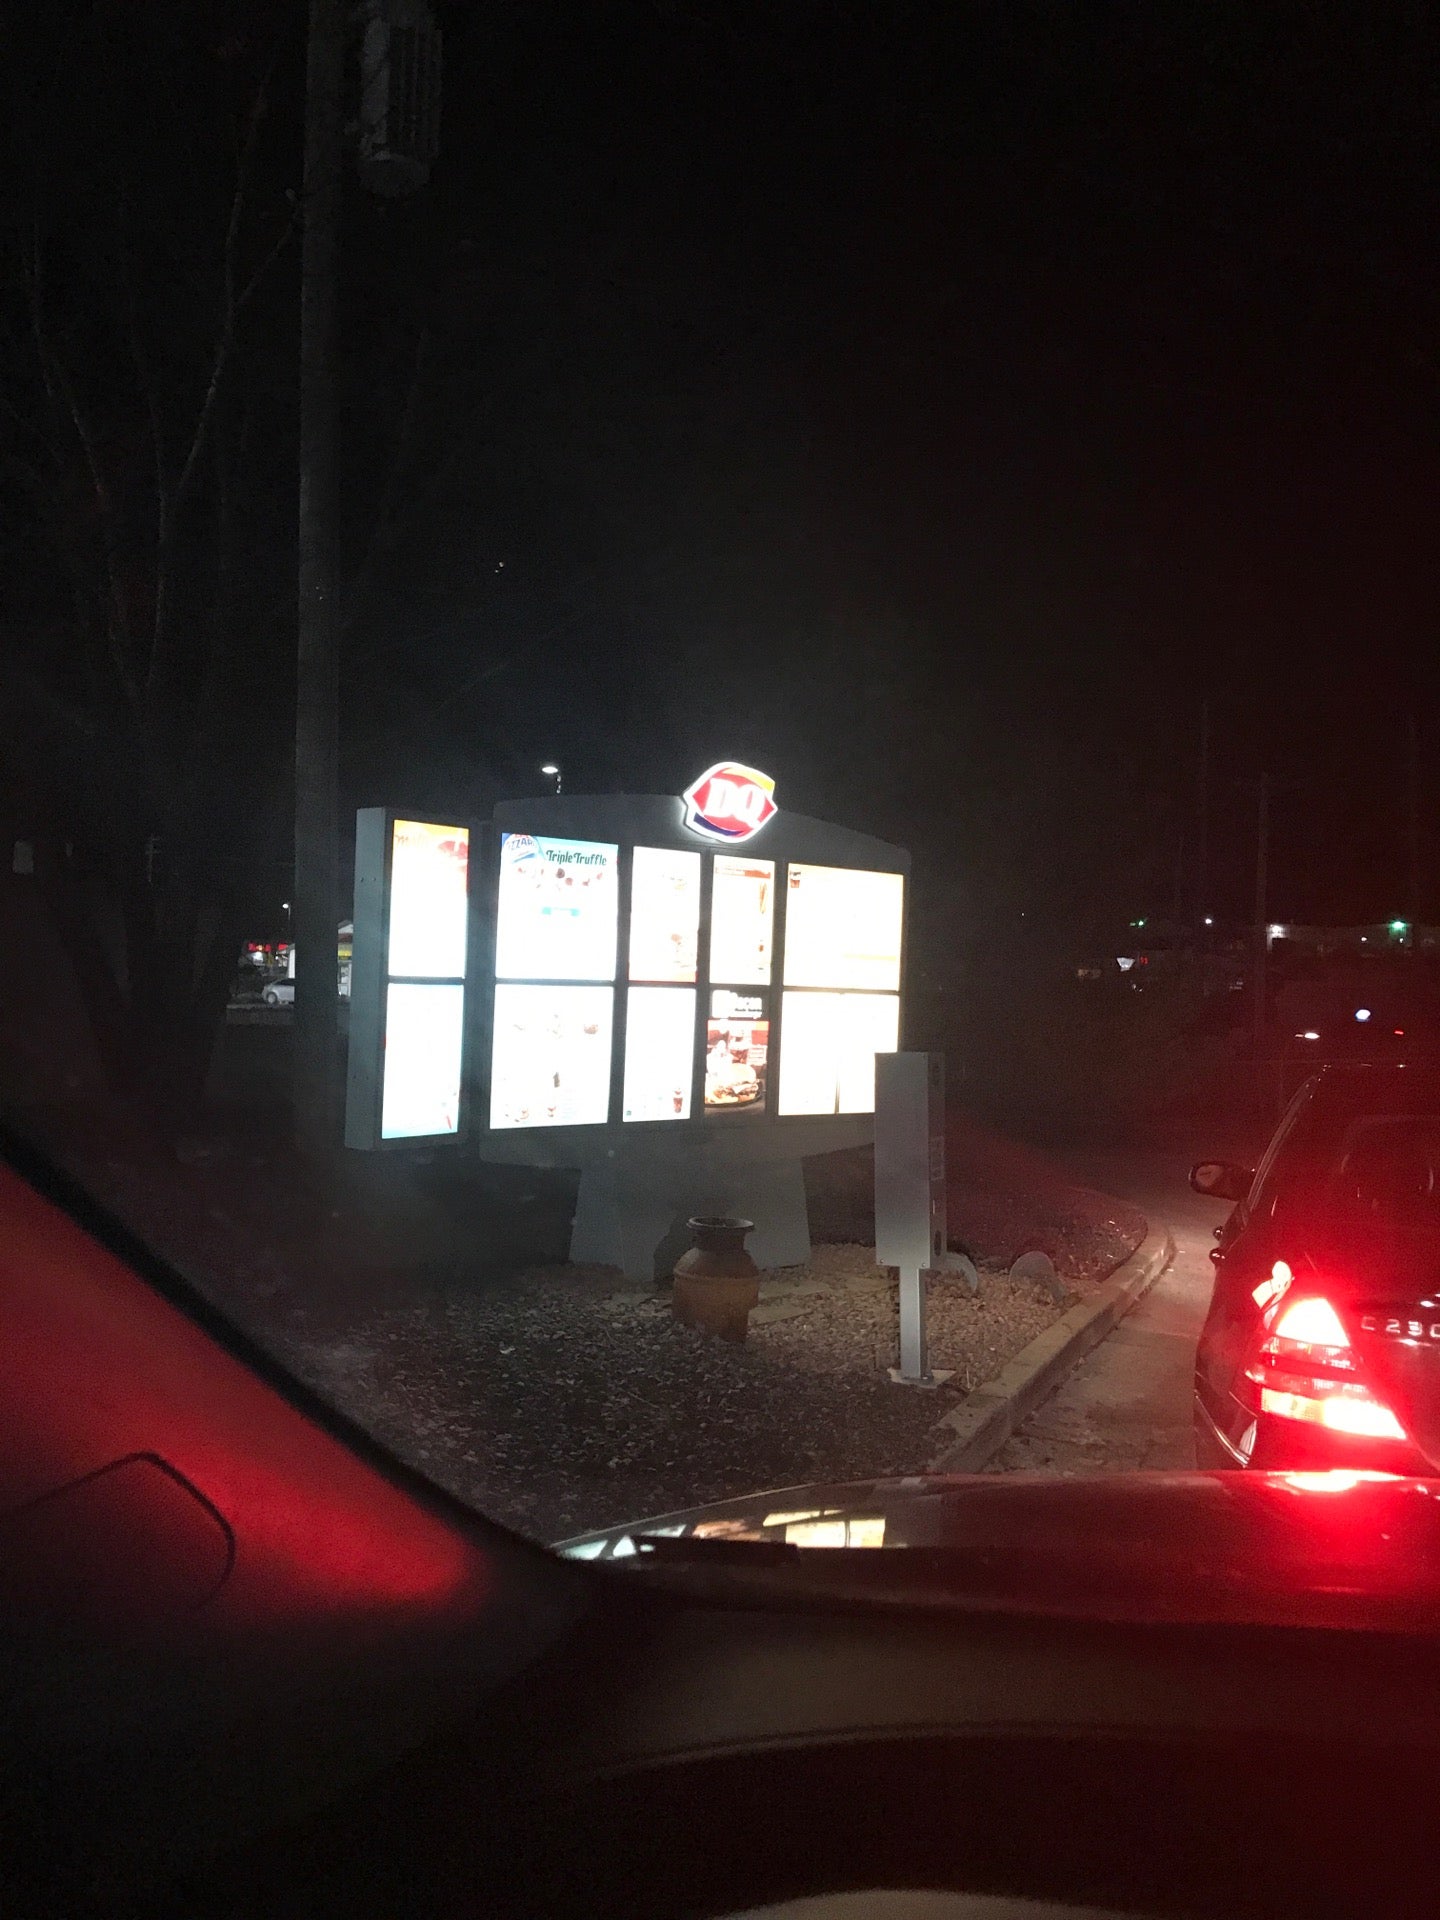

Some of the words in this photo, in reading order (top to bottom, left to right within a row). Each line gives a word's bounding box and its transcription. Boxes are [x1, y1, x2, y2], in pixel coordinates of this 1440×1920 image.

[703, 778, 766, 828] DQ
[546, 849, 573, 865] Triple
[573, 852, 607, 866] Truffle
